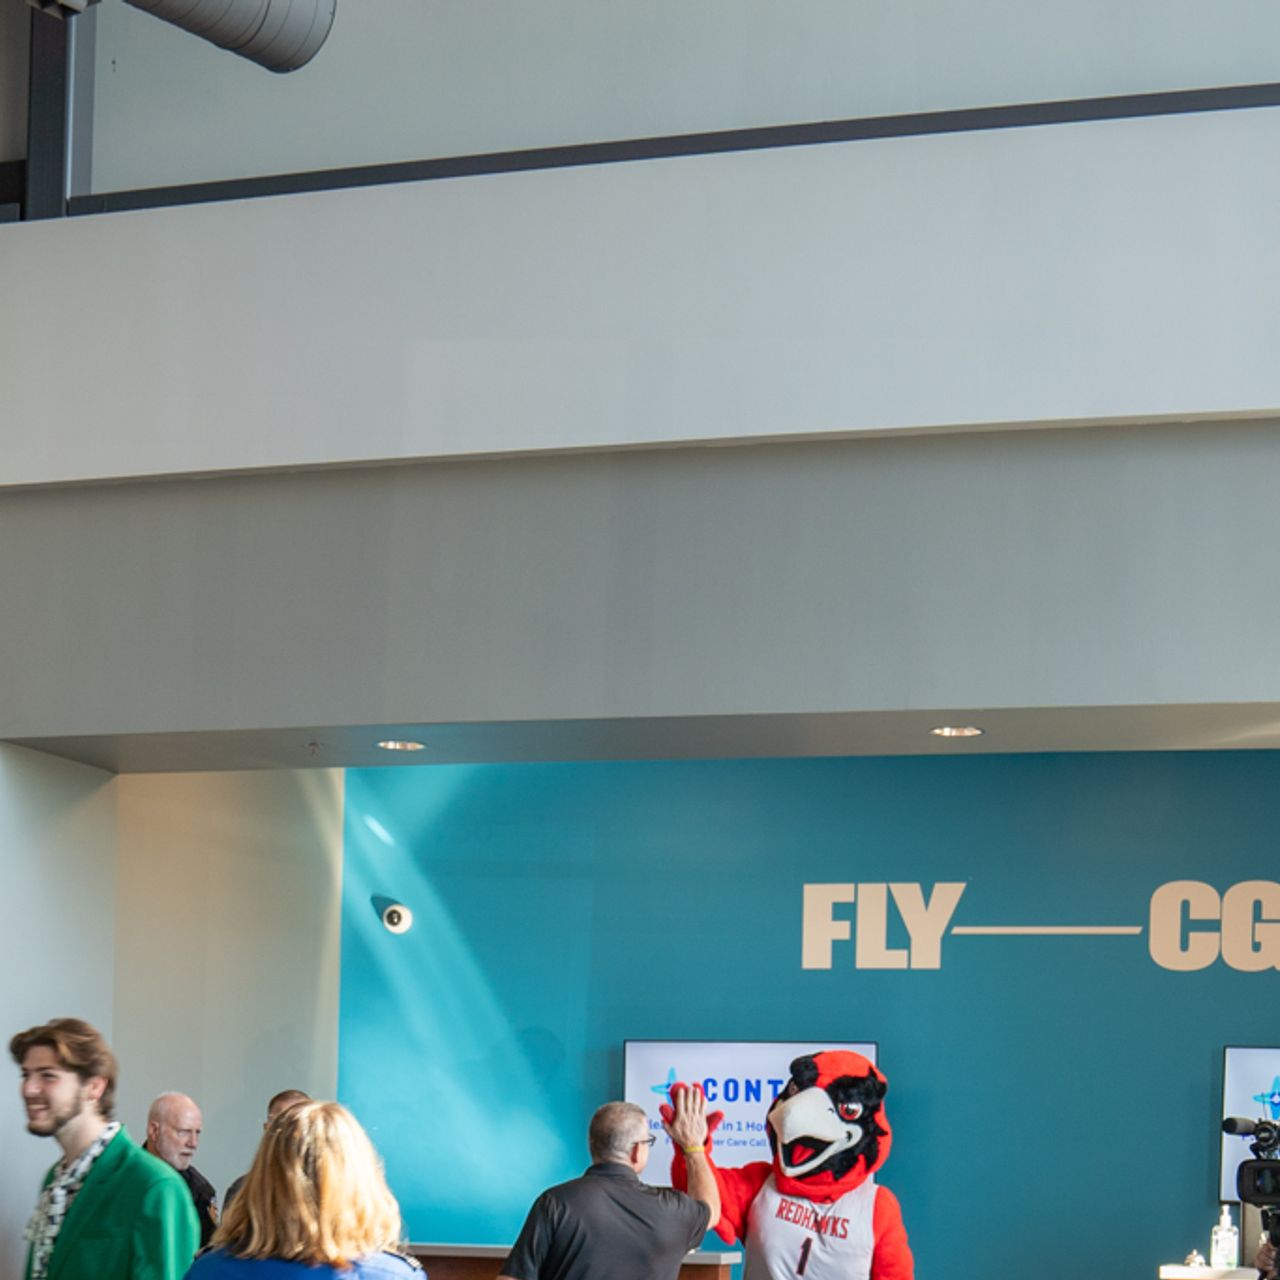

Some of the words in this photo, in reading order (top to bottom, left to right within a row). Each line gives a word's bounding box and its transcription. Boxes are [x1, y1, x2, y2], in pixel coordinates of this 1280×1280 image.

[802, 883, 967, 970] FLY
[703, 1078, 784, 1102] CONT
[776, 1198, 850, 1239] REDHAWKS
[796, 1236, 813, 1276] 1
